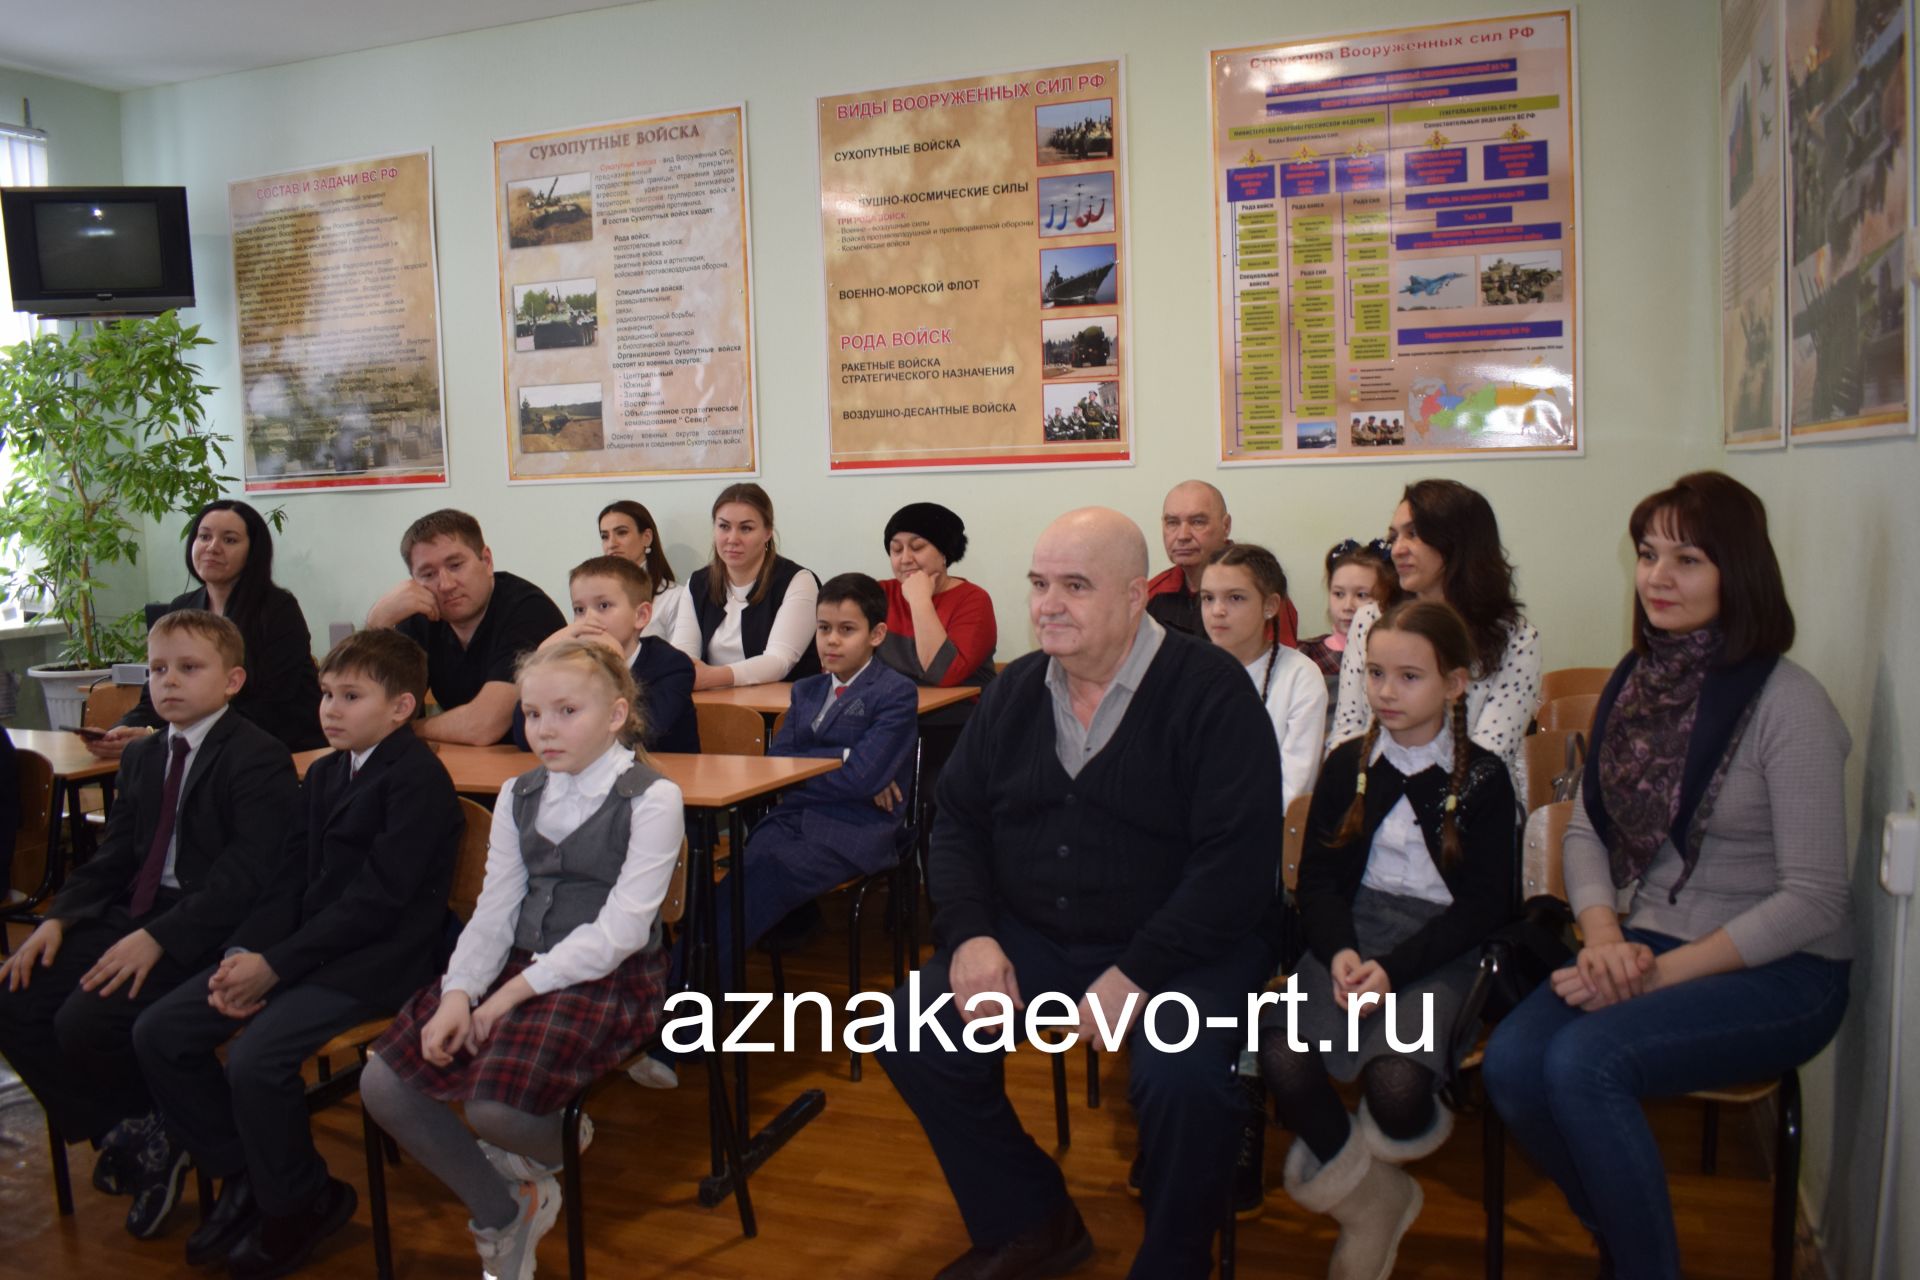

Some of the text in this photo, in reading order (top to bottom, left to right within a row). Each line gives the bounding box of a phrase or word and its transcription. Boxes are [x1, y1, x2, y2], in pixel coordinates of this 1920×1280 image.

[1340, 37, 1463, 59] Вооруженных
[1470, 32, 1502, 43] сил
[1509, 26, 1535, 40] РФ
[837, 74, 1105, 121] ВИДЫ ВООРУЖЕННЫХ СИЛ РФ
[529, 124, 700, 160] СУХОПУТНЫЕ ВОЙСКА
[834, 138, 961, 162] СУХОПУТНЫЕ ВОЙСКА
[257, 167, 398, 200] СОСТАВ И ЗАДАЧИ ВС РФ
[993, 181, 1029, 196] СИЛЫ
[608, 216, 629, 224] состав
[631, 212, 668, 223] Сухопутных
[939, 222, 999, 235] противоракетной
[1002, 218, 1033, 229] обороны
[614, 234, 629, 242] Рода
[616, 285, 659, 296] Специальные
[839, 279, 980, 300] ВОЕННО-МОРСКОЙ ФЛОТ
[841, 327, 951, 350] РОДА ВОЙСК
[617, 349, 669, 360] Организационно
[674, 346, 713, 356] Сухопутные
[842, 357, 940, 372] РАКЕТНЫЕ ВОЙСКА
[842, 365, 1015, 384] СТРАТЕГИЧЕСКОГО НАЗНАЧЕНИЯ
[843, 402, 1017, 420] ВОЗДУШНО-ДЕСАНТНЫЕ ВОЙСКА
